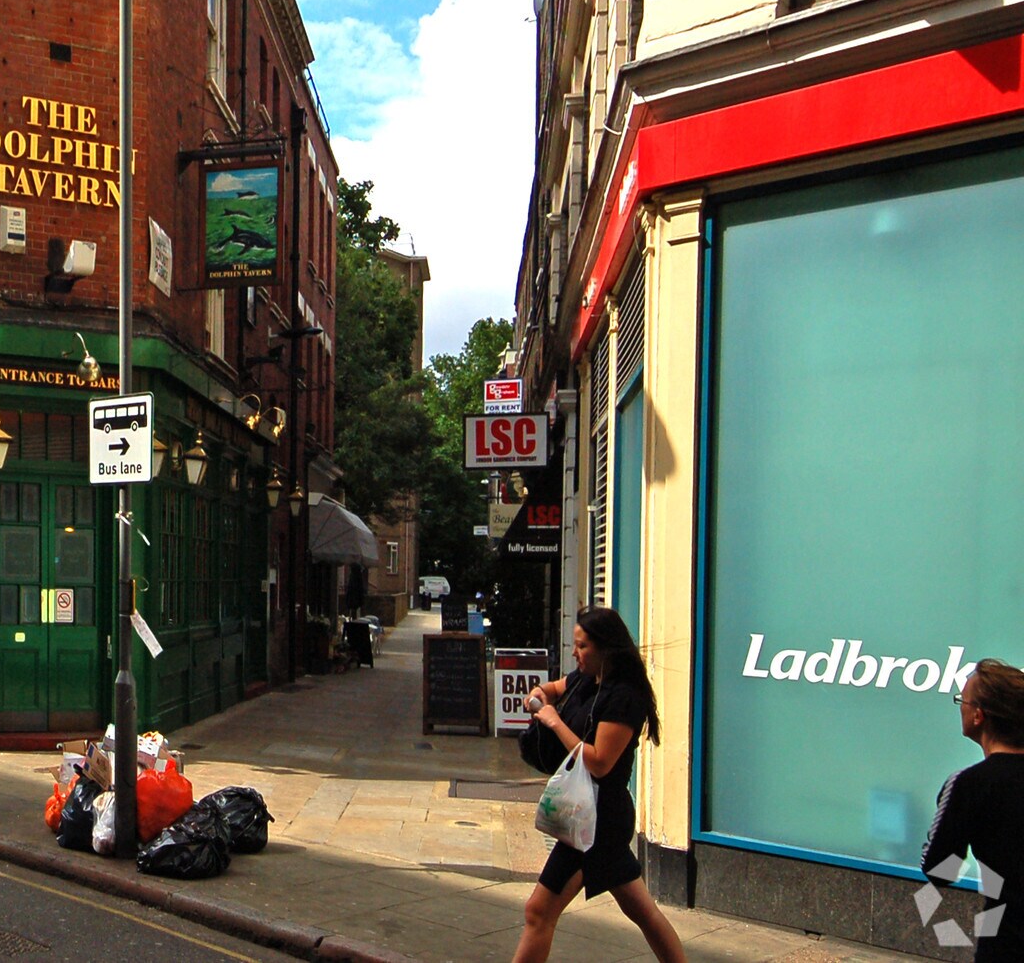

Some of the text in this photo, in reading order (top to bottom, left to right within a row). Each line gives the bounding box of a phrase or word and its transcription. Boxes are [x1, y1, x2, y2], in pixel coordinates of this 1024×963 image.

[22, 96, 97, 135] THE
[67, 373, 86, 386] TO
[485, 403, 521, 412] FOR RENT
[476, 417, 536, 456] LSC
[98, 462, 142, 475] Bus lane
[528, 504, 560, 525] LSC
[508, 543, 558, 553] fully licensed
[742, 633, 977, 693] Ladbrok
[502, 674, 541, 695] BAR
[502, 697, 530, 713] OP
